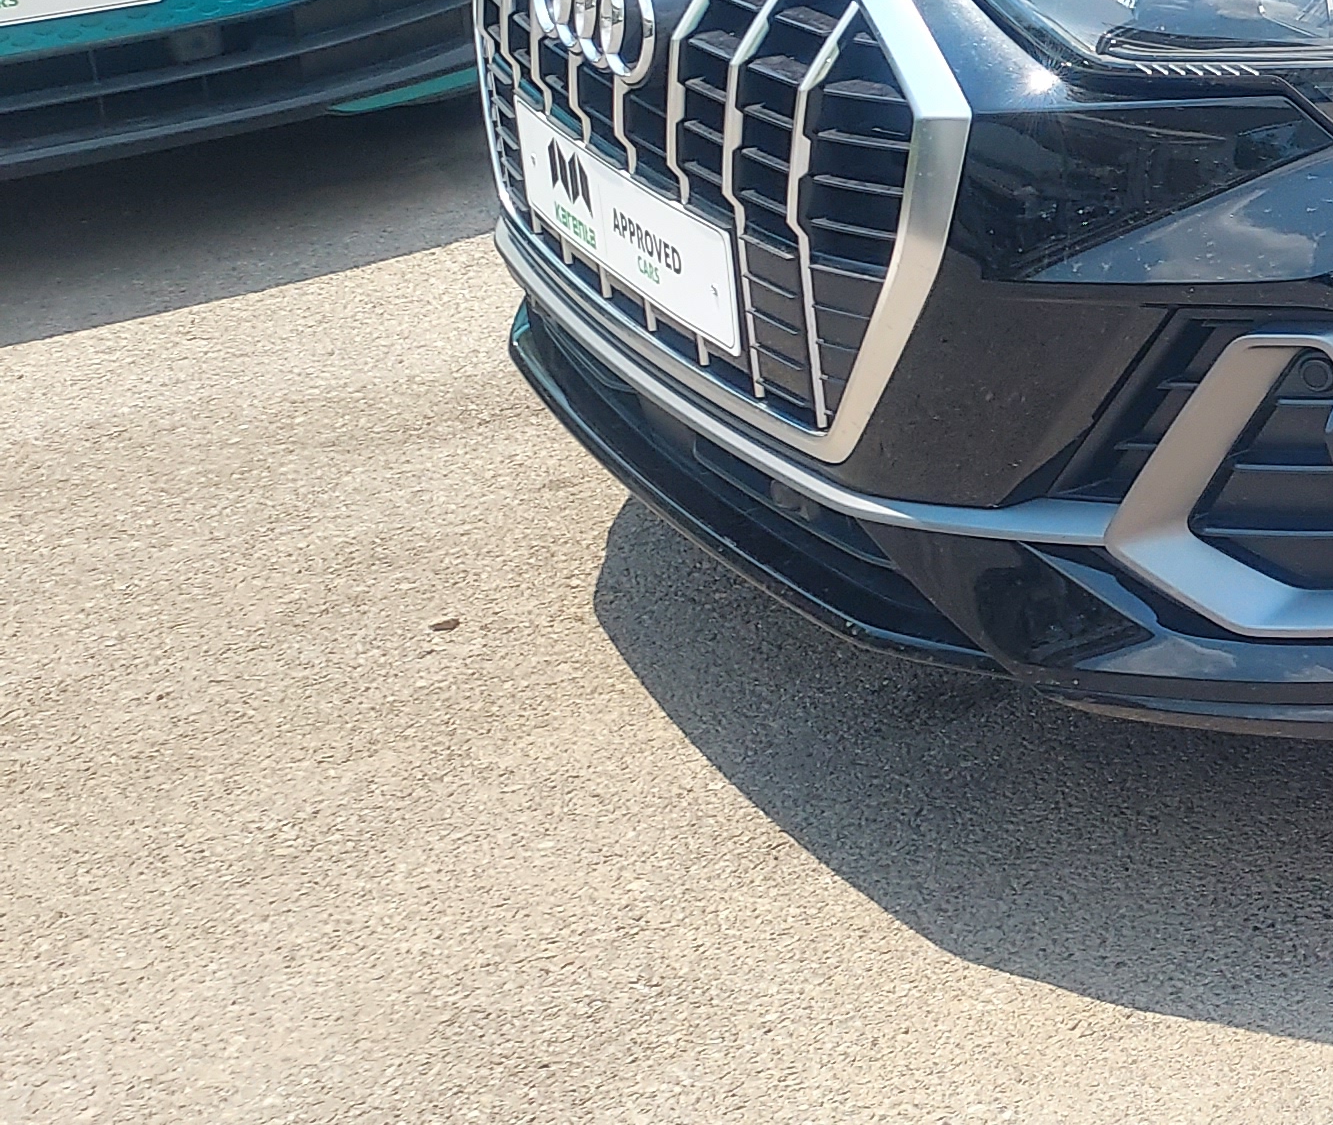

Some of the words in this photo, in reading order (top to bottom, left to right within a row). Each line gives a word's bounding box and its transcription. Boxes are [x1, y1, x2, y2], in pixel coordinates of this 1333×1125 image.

[554, 201, 597, 250] karenta
[613, 208, 682, 275] APPROVED
[637, 255, 660, 285] CARS
